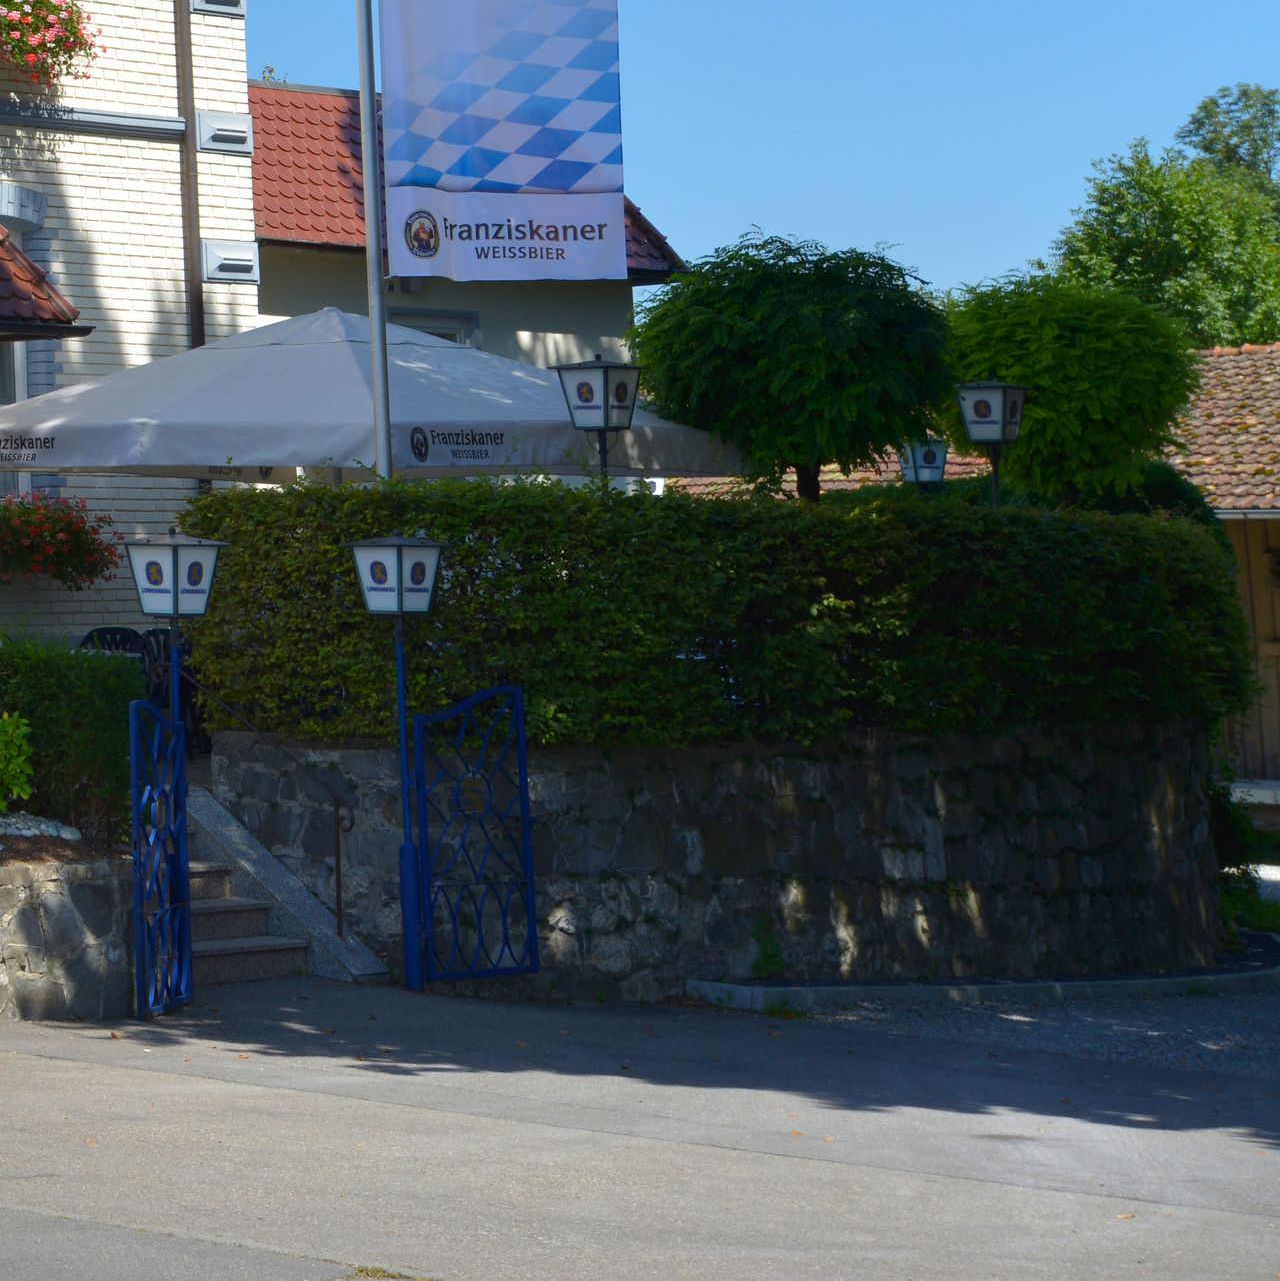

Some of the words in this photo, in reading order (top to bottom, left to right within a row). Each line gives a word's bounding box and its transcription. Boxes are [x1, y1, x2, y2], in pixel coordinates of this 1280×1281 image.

[442, 217, 608, 242] Franziskaner
[474, 246, 566, 261] WEISSBIER
[429, 428, 505, 446] Franziskaner
[450, 448, 490, 460] WEISSBIER
